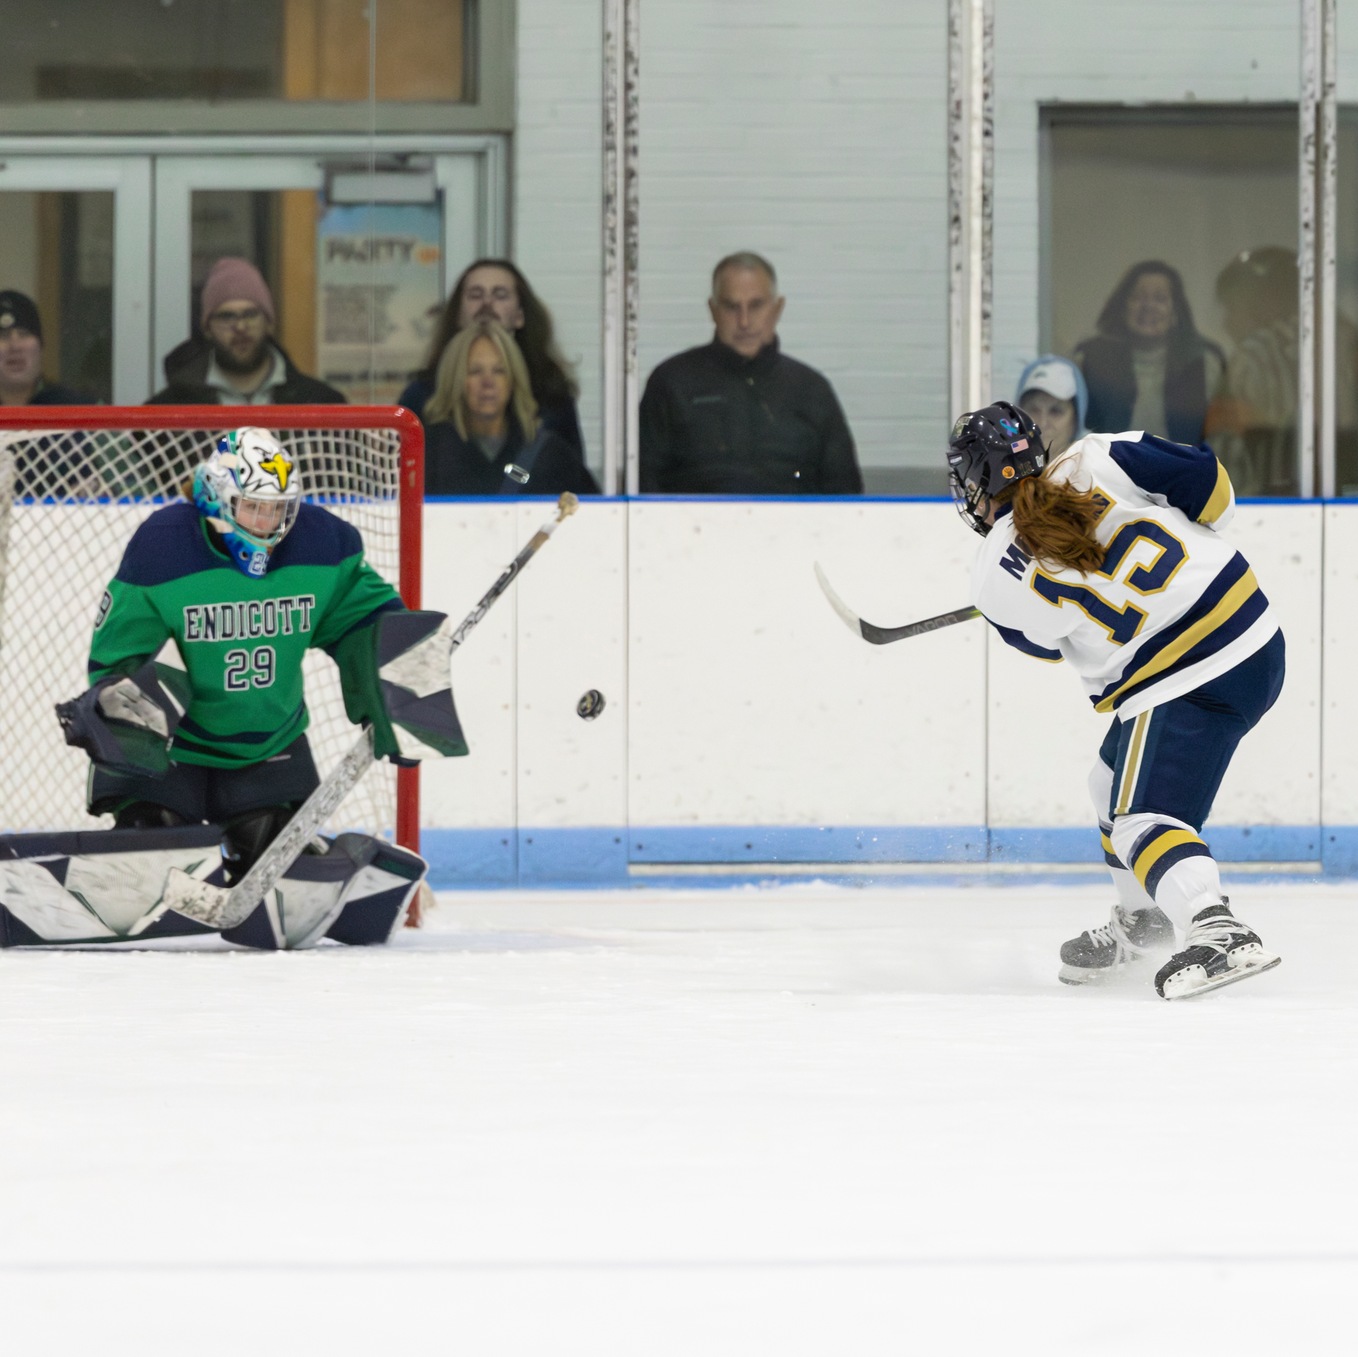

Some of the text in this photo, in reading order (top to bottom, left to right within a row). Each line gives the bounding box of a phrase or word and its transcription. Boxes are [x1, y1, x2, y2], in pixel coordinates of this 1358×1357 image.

[1030, 486, 1190, 646] 15
[183, 594, 316, 642] ENDICOTT
[224, 645, 276, 692] 29
